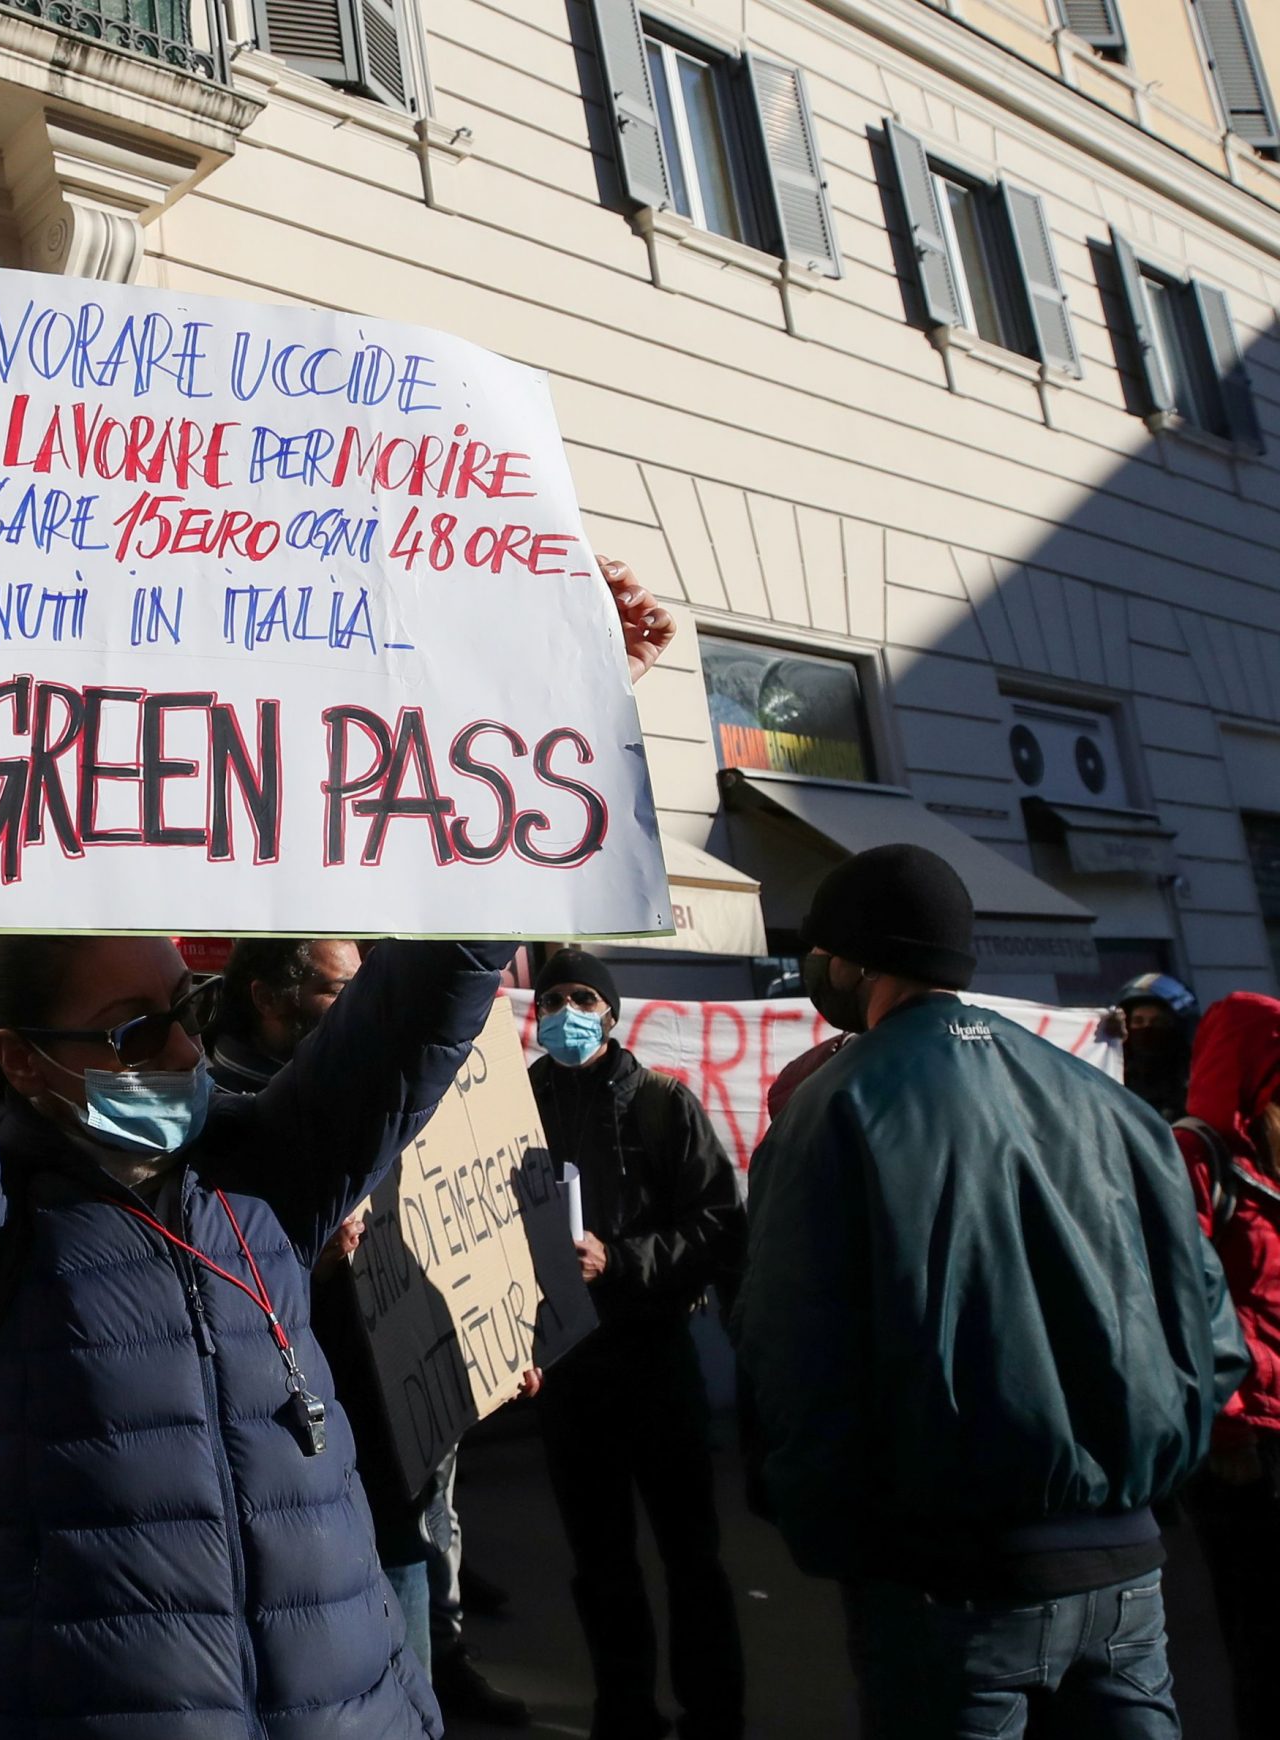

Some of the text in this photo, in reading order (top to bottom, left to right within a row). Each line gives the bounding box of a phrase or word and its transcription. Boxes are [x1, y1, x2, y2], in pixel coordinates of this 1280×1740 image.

[3, 394, 242, 489] LAVORARE
[249, 425, 334, 487] PER
[331, 423, 538, 500] MORIRE
[285, 505, 379, 564] OGNI
[130, 570, 183, 646] IN
[320, 703, 610, 869] PASS
[672, 904, 694, 930] BI
[624, 998, 827, 1172] GRE
[434, 1127, 562, 1258] EMERGENZA
